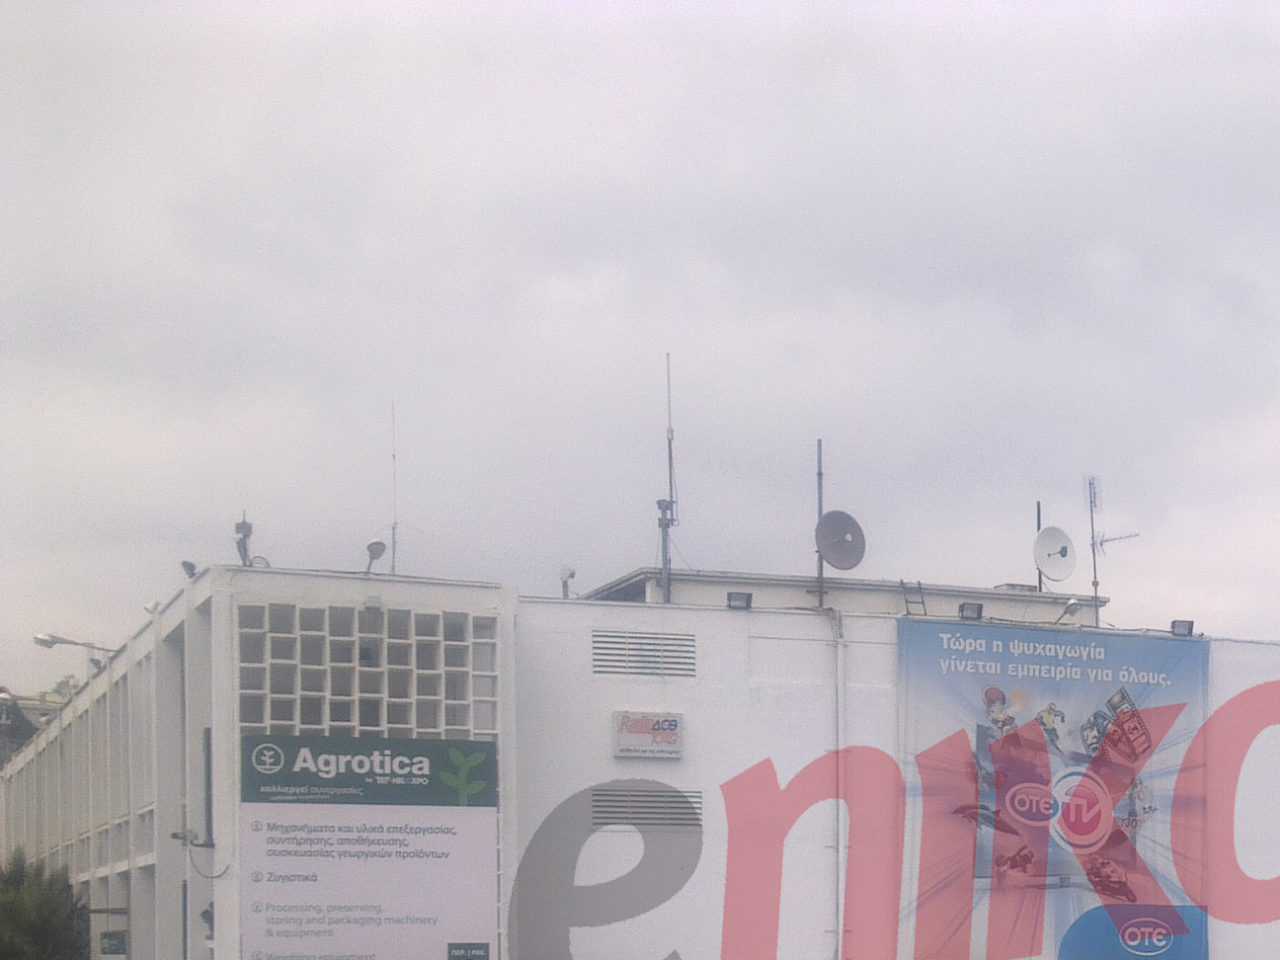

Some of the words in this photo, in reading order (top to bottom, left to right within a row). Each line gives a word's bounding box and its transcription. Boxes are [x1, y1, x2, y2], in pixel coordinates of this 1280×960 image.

[939, 633, 986, 653] Τώρα
[992, 640, 1002, 653] η
[1009, 639, 1105, 661] ψυχαγωγία
[939, 657, 1002, 674] γίνεται
[1008, 662, 1081, 680] εμπειρία
[1088, 668, 1112, 682] για
[1119, 669, 1172, 688] όλους.
[293, 747, 431, 779] Agrotica
